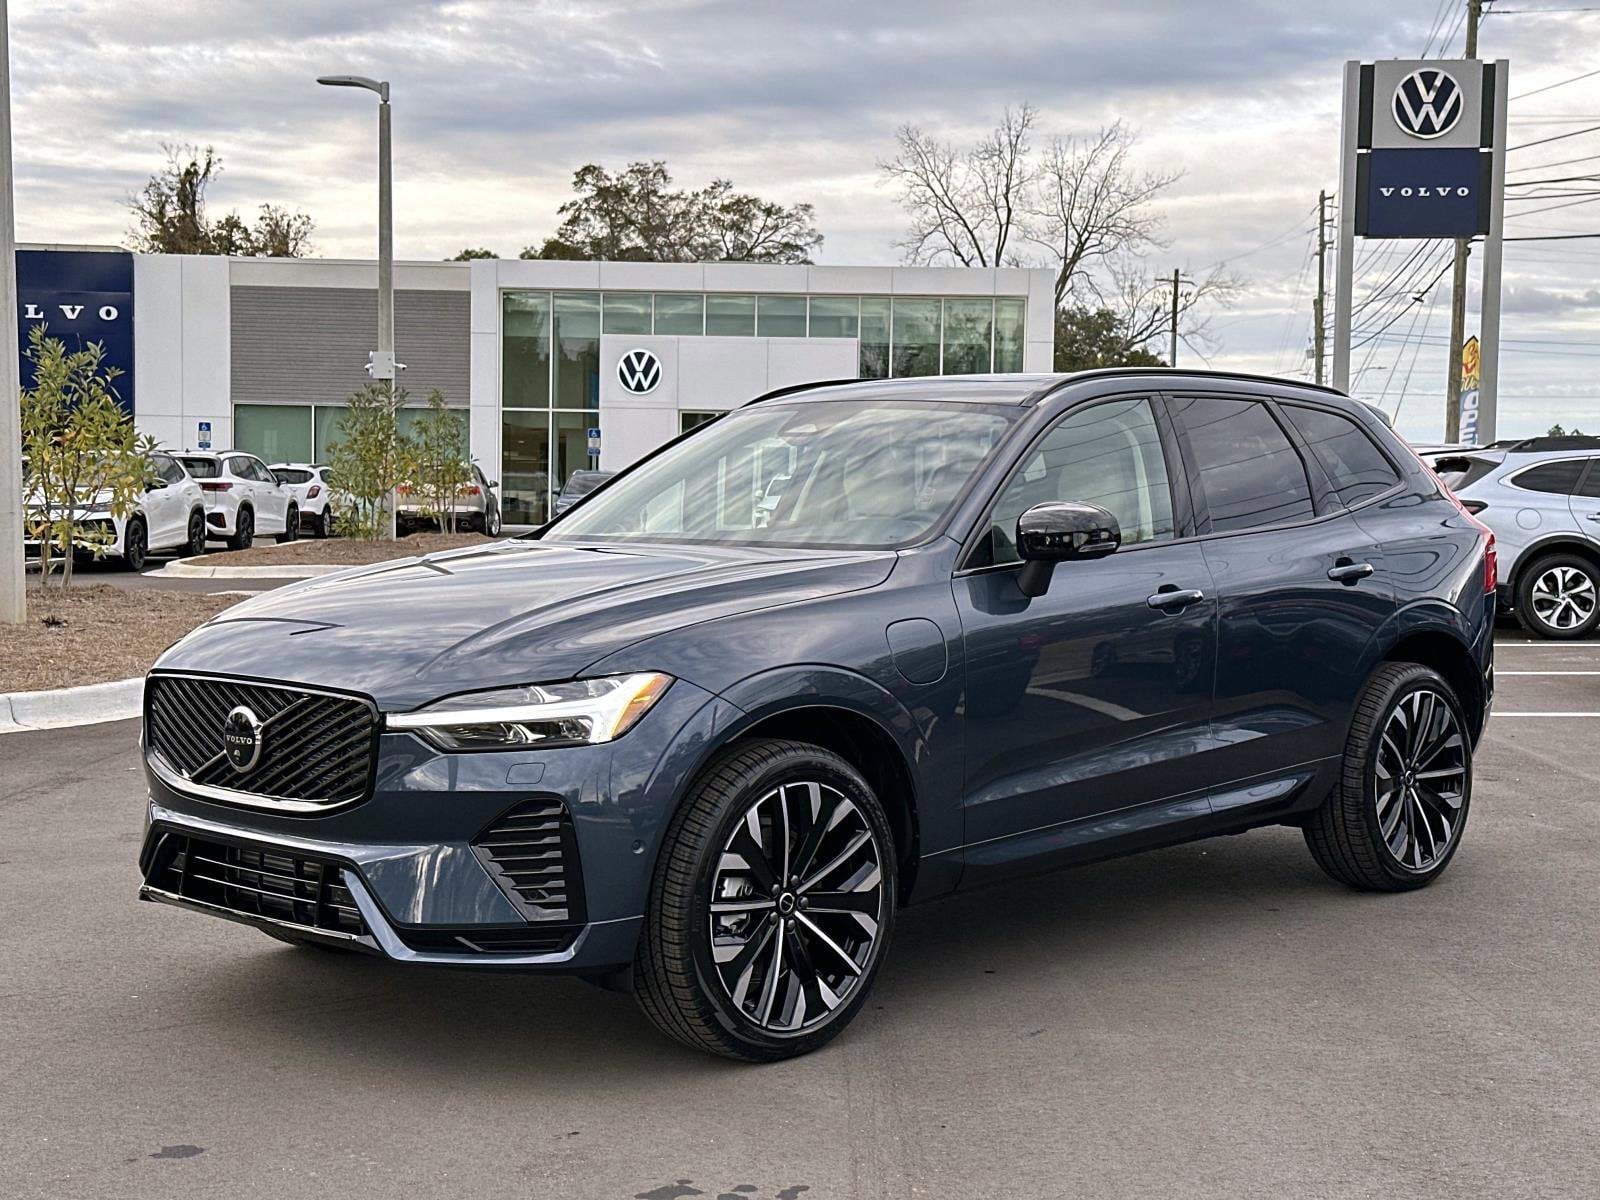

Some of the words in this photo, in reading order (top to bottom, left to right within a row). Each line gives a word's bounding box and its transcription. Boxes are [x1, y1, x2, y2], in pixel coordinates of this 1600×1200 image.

[1394, 69, 1462, 135] VW
[1379, 186, 1470, 197] VOLVO
[24, 304, 119, 321] LVO
[618, 350, 661, 393] VW
[225, 734, 253, 745] VOLVO
